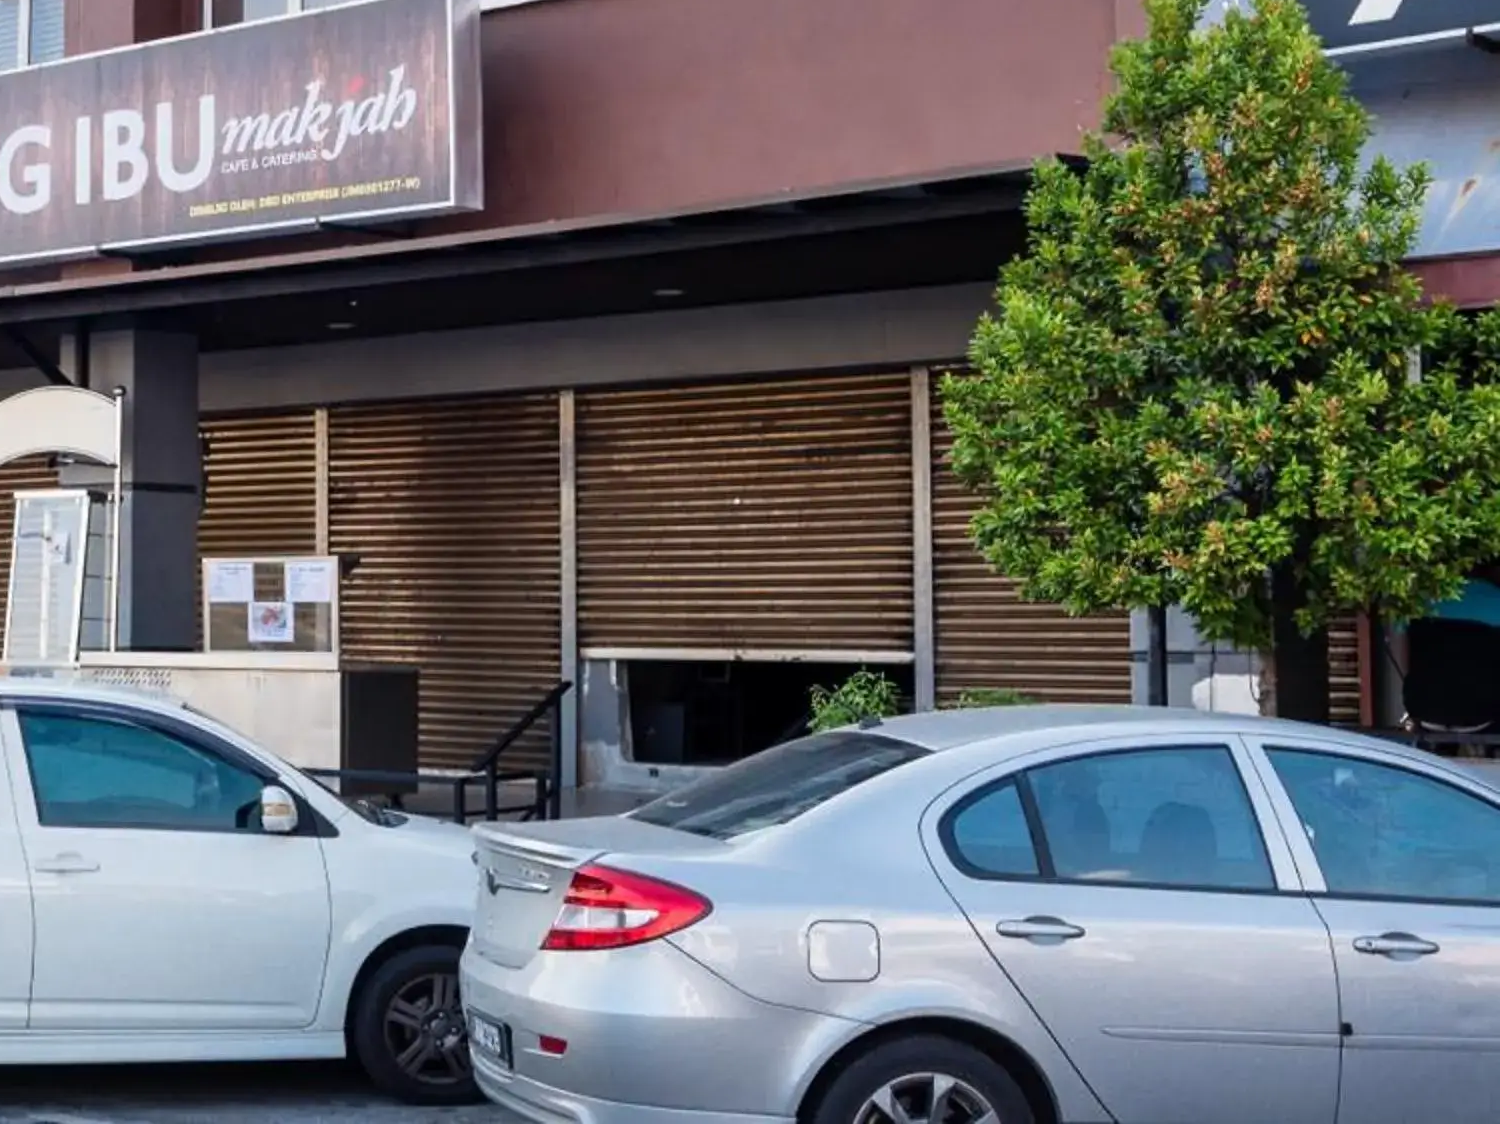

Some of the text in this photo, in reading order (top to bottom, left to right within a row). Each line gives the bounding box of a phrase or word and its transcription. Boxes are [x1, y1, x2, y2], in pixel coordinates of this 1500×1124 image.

[75, 95, 215, 206] IBU
[220, 63, 418, 161] mak jah
[261, 149, 318, 169] CATERING
